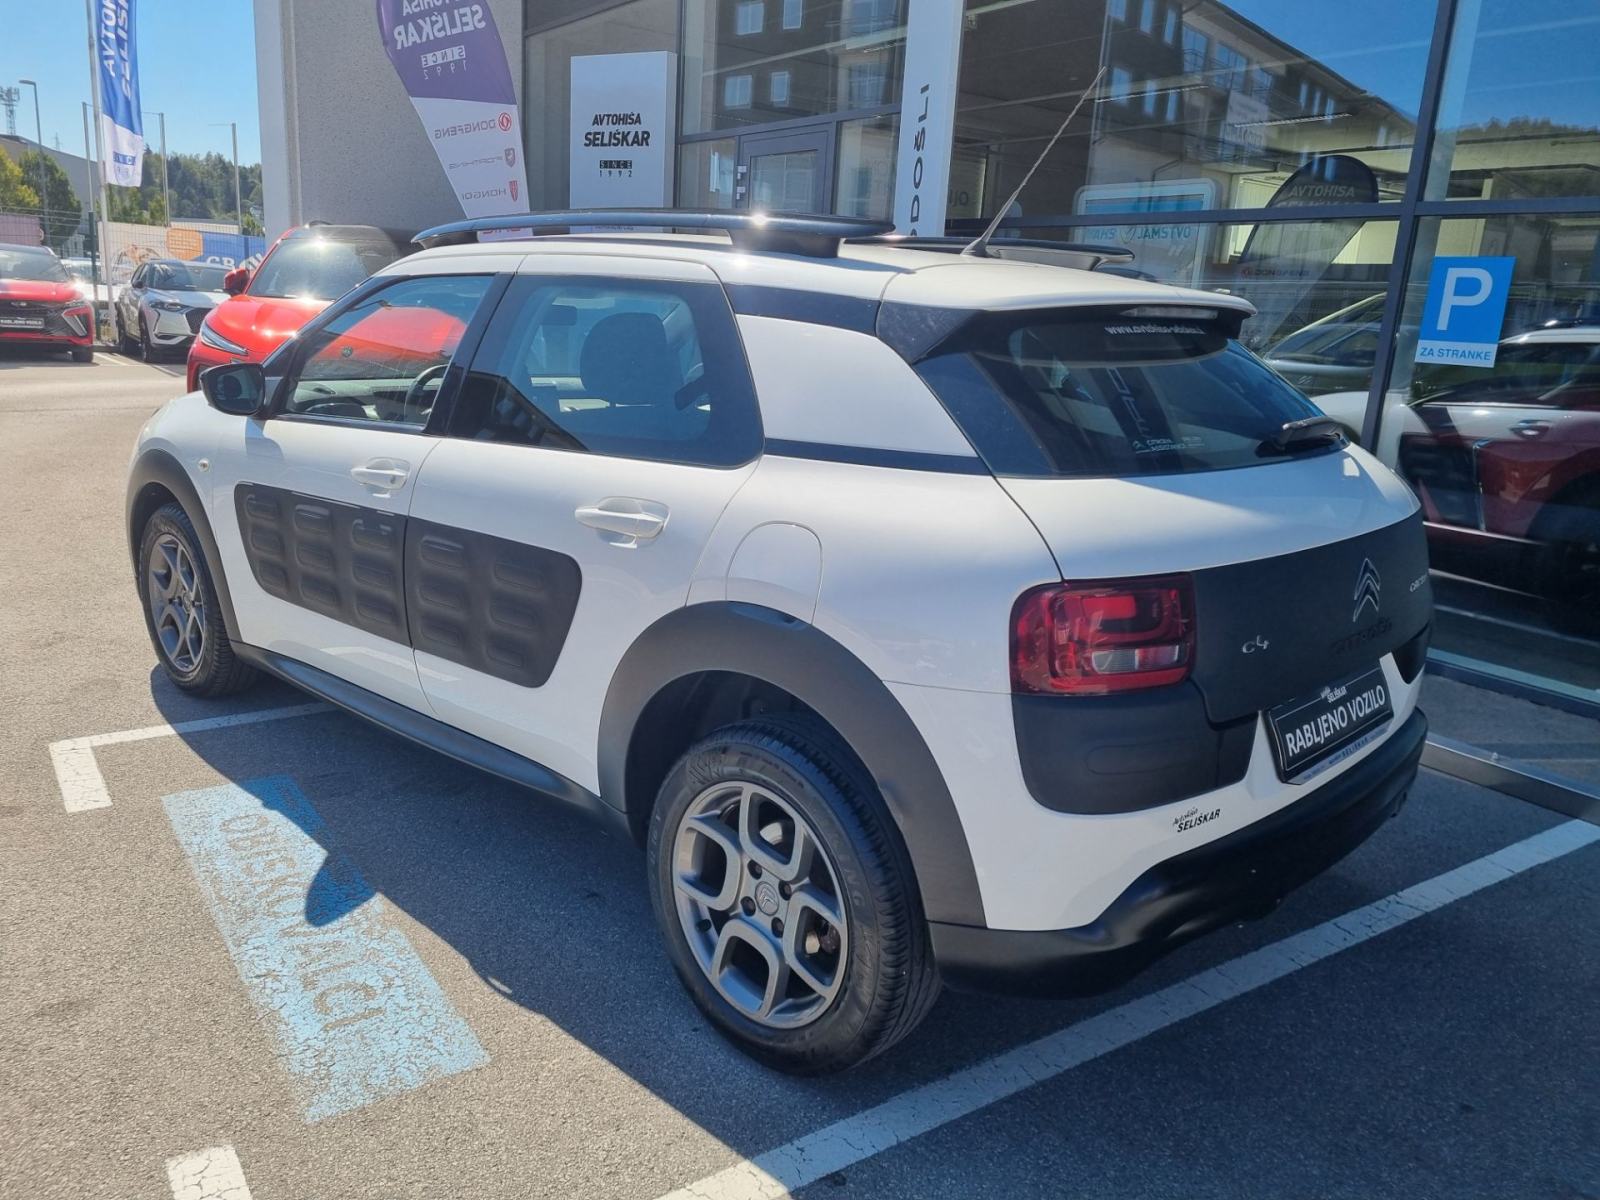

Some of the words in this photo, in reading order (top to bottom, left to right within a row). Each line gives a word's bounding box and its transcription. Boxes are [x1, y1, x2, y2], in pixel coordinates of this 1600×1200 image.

[910, 83, 930, 237] DOŠLI
[1137, 226, 1191, 240] JAMSTVO
[1436, 267, 1493, 331] P
[1419, 346, 1435, 358] ZA
[1436, 348, 1492, 361] STRANKE
[1242, 634, 1270, 653] C4
[1285, 705, 1348, 757] RABLJENO
[1346, 685, 1386, 721] VOZILO
